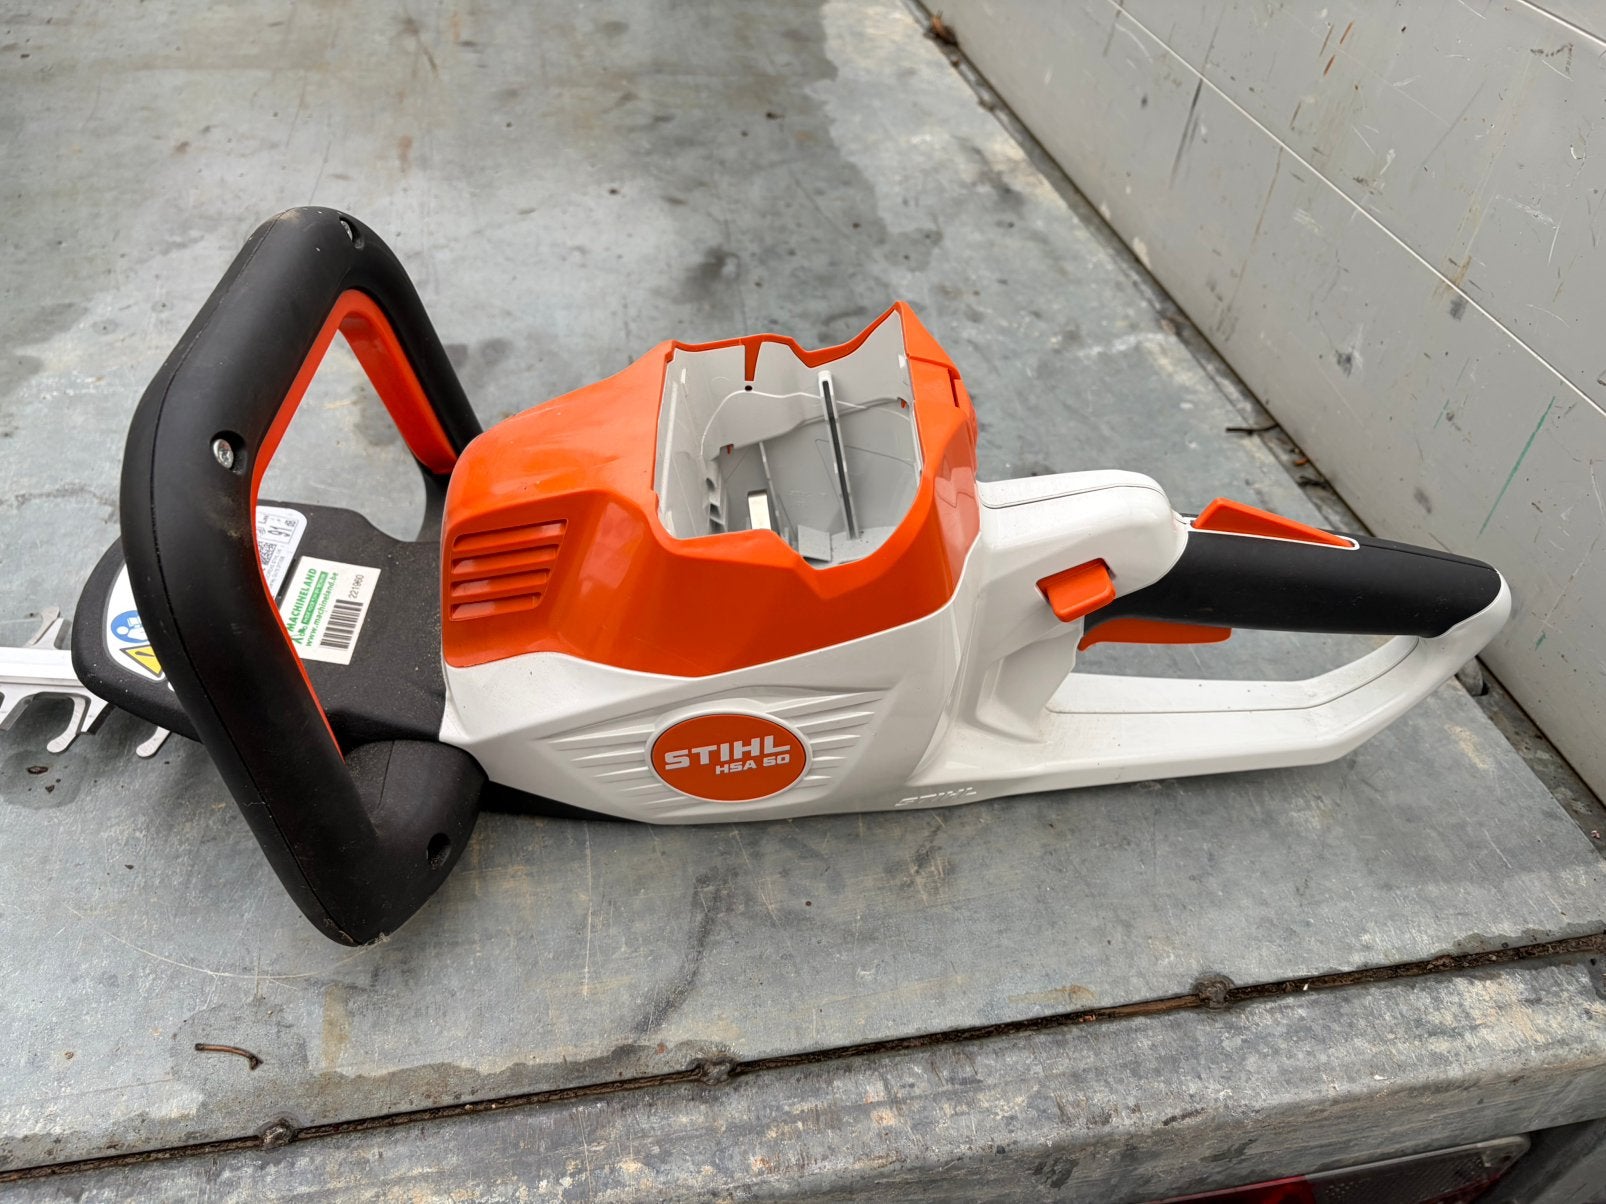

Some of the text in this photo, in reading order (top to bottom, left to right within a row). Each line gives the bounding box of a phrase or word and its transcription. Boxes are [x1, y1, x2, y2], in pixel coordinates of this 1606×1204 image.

[287, 568, 317, 631] MACHINELAND
[306, 572, 338, 646] www.machineland.be
[664, 735, 791, 770] STIHL
[715, 754, 790, 775] HSA 50
